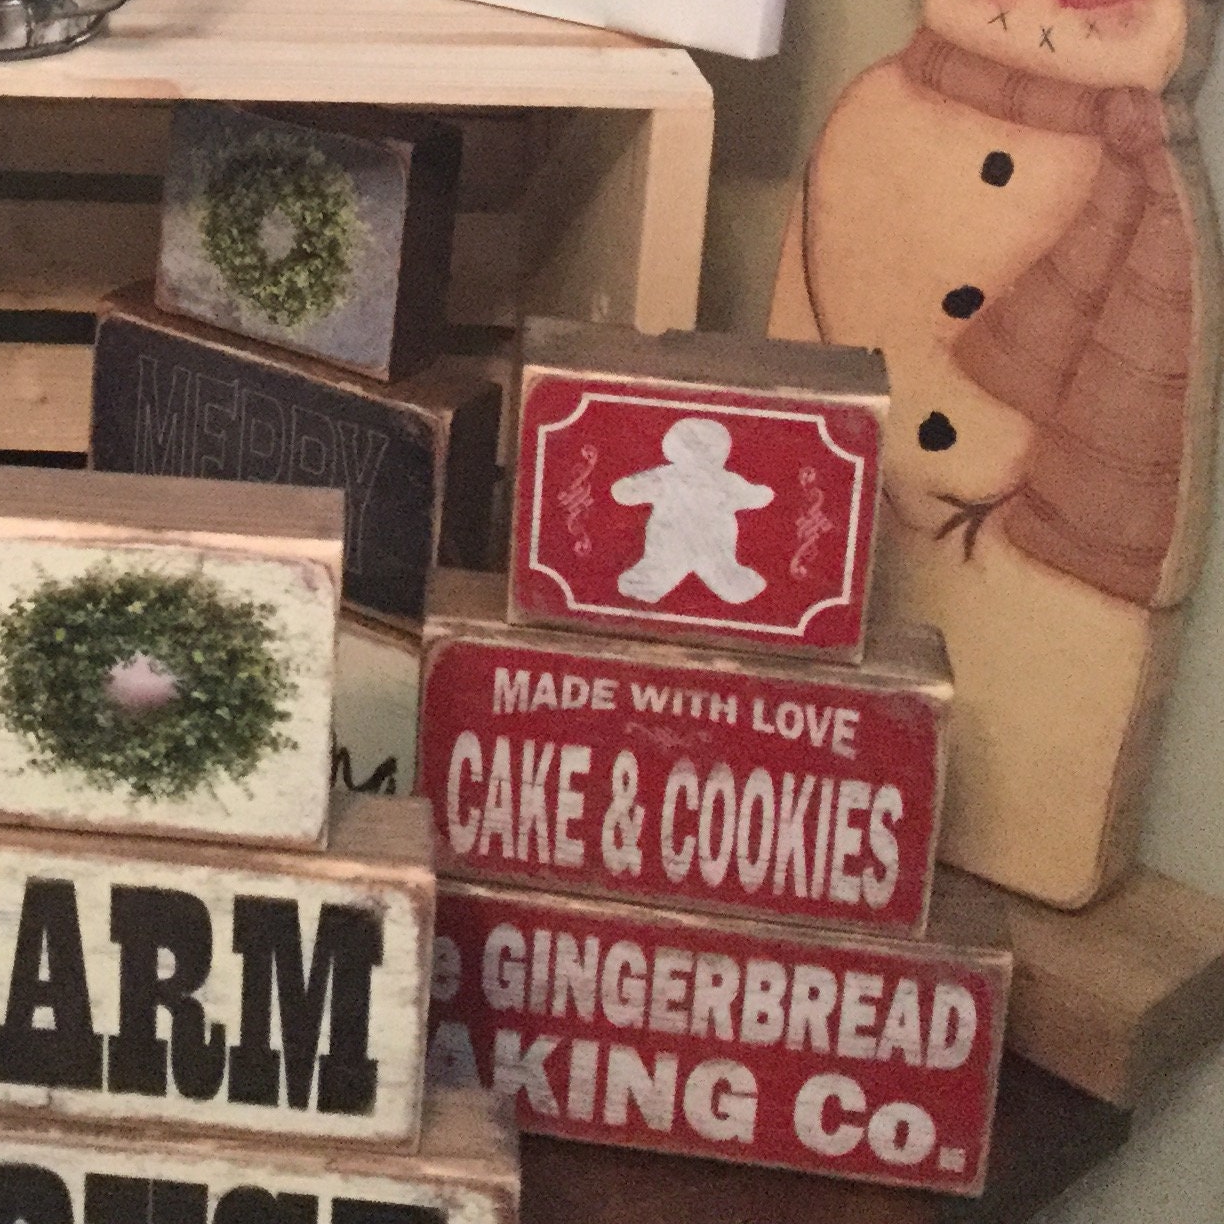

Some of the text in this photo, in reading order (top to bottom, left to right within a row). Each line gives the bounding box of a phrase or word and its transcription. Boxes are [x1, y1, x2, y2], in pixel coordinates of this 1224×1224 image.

[492, 668, 861, 760] MADE WITH LOVE
[447, 730, 904, 909] CAKE & COOKIES
[481, 923, 977, 1070] GINGERBREAD
[427, 1020, 966, 1173] AKING Co.
